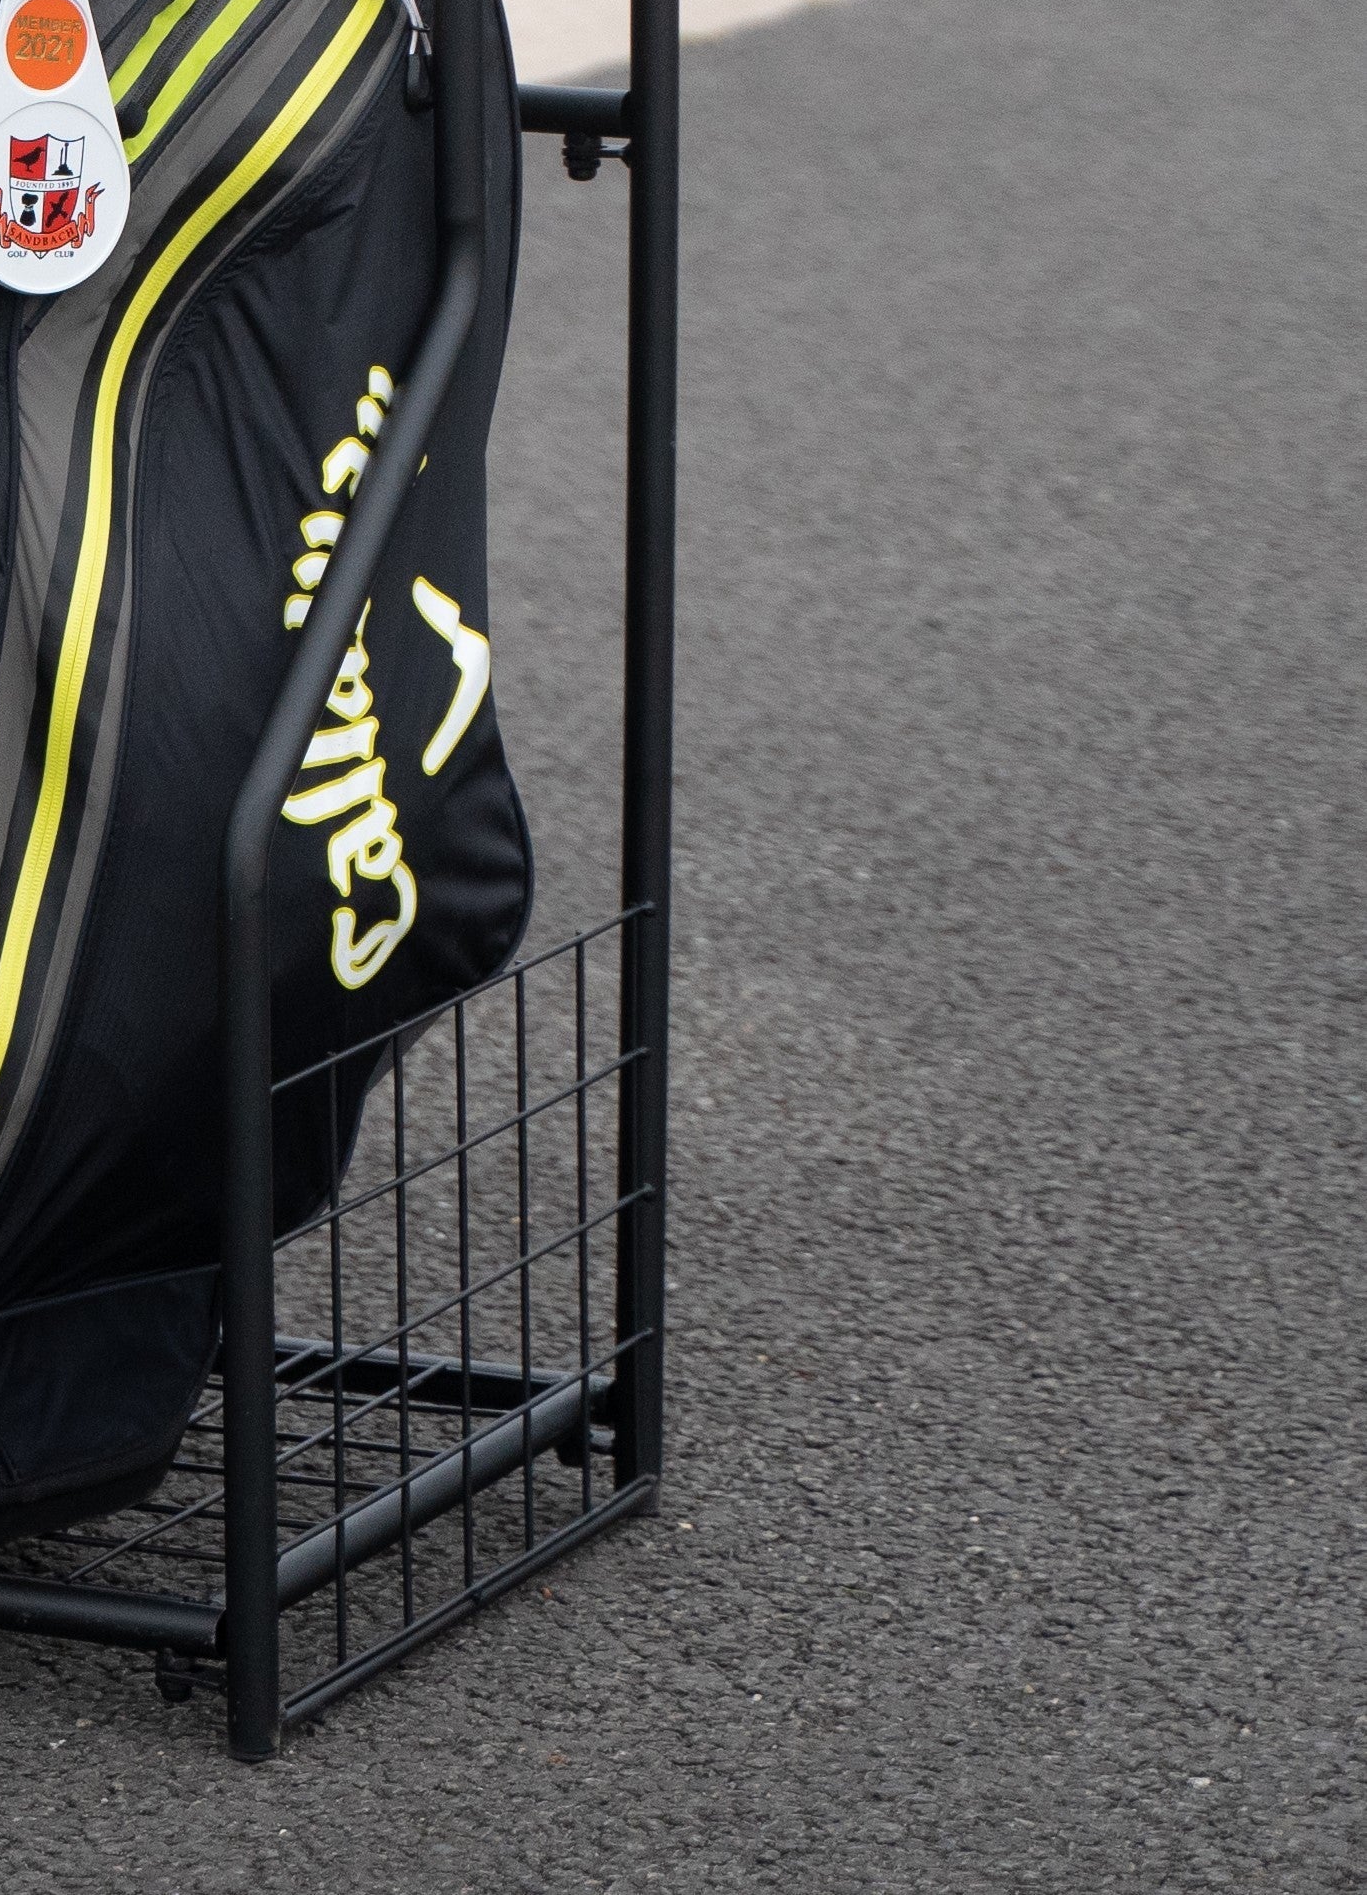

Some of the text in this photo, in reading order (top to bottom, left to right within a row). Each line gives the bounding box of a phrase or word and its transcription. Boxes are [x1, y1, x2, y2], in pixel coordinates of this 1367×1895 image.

[15, 31, 74, 64] 2021
[15, 180, 55, 189] FOUNDED
[8, 227, 76, 246] SANDBACH
[7, 250, 75, 258] GOLF CLUB
